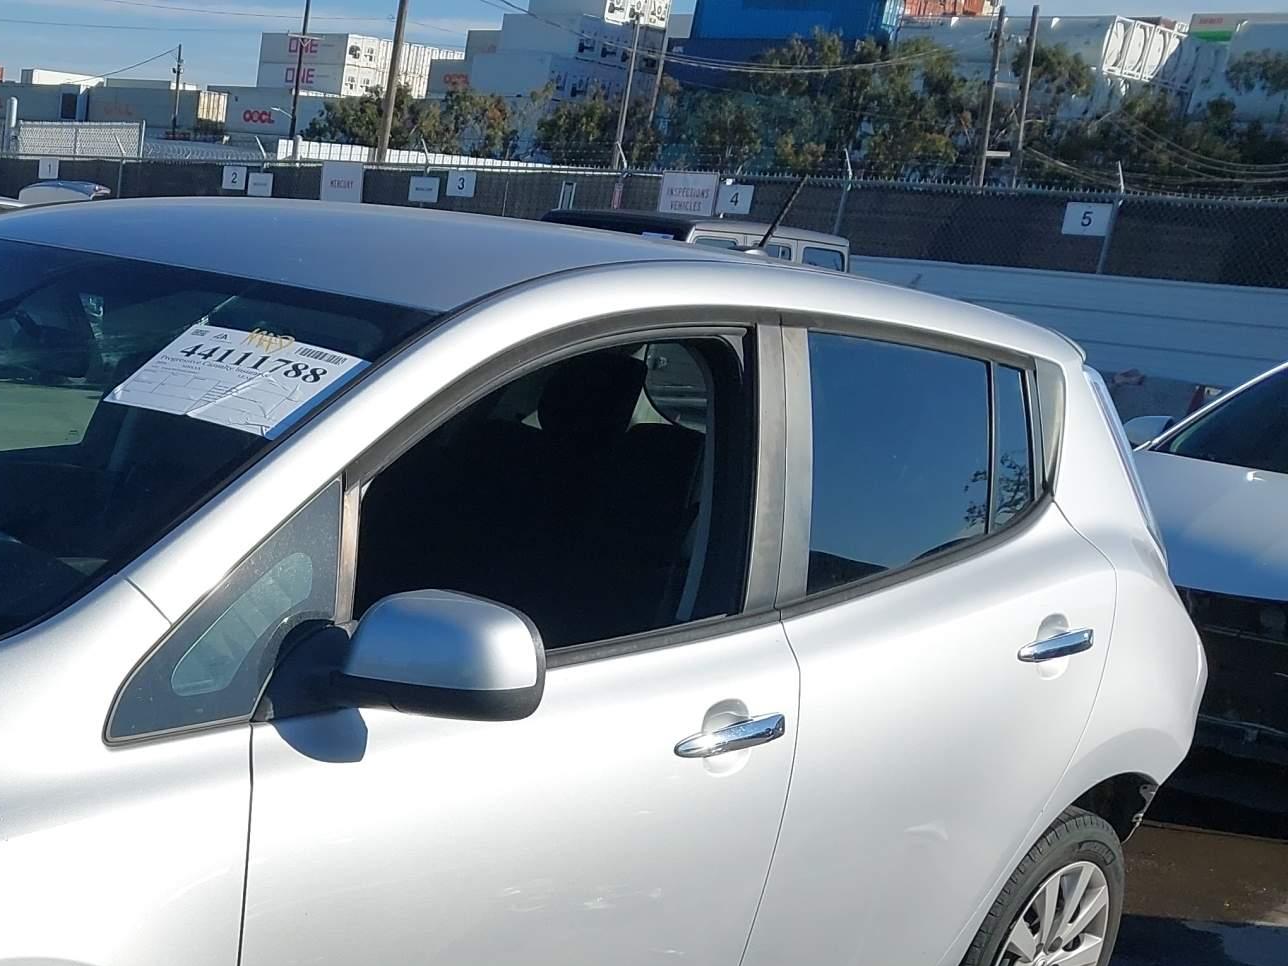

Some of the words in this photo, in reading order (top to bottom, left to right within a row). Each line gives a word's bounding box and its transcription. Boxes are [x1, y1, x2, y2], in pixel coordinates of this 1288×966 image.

[243, 109, 275, 124] OOCL
[231, 172, 238, 184] 2
[457, 177, 465, 190] 3
[730, 192, 739, 206] 4
[1081, 211, 1093, 227] 5
[180, 342, 328, 383] 44111788
